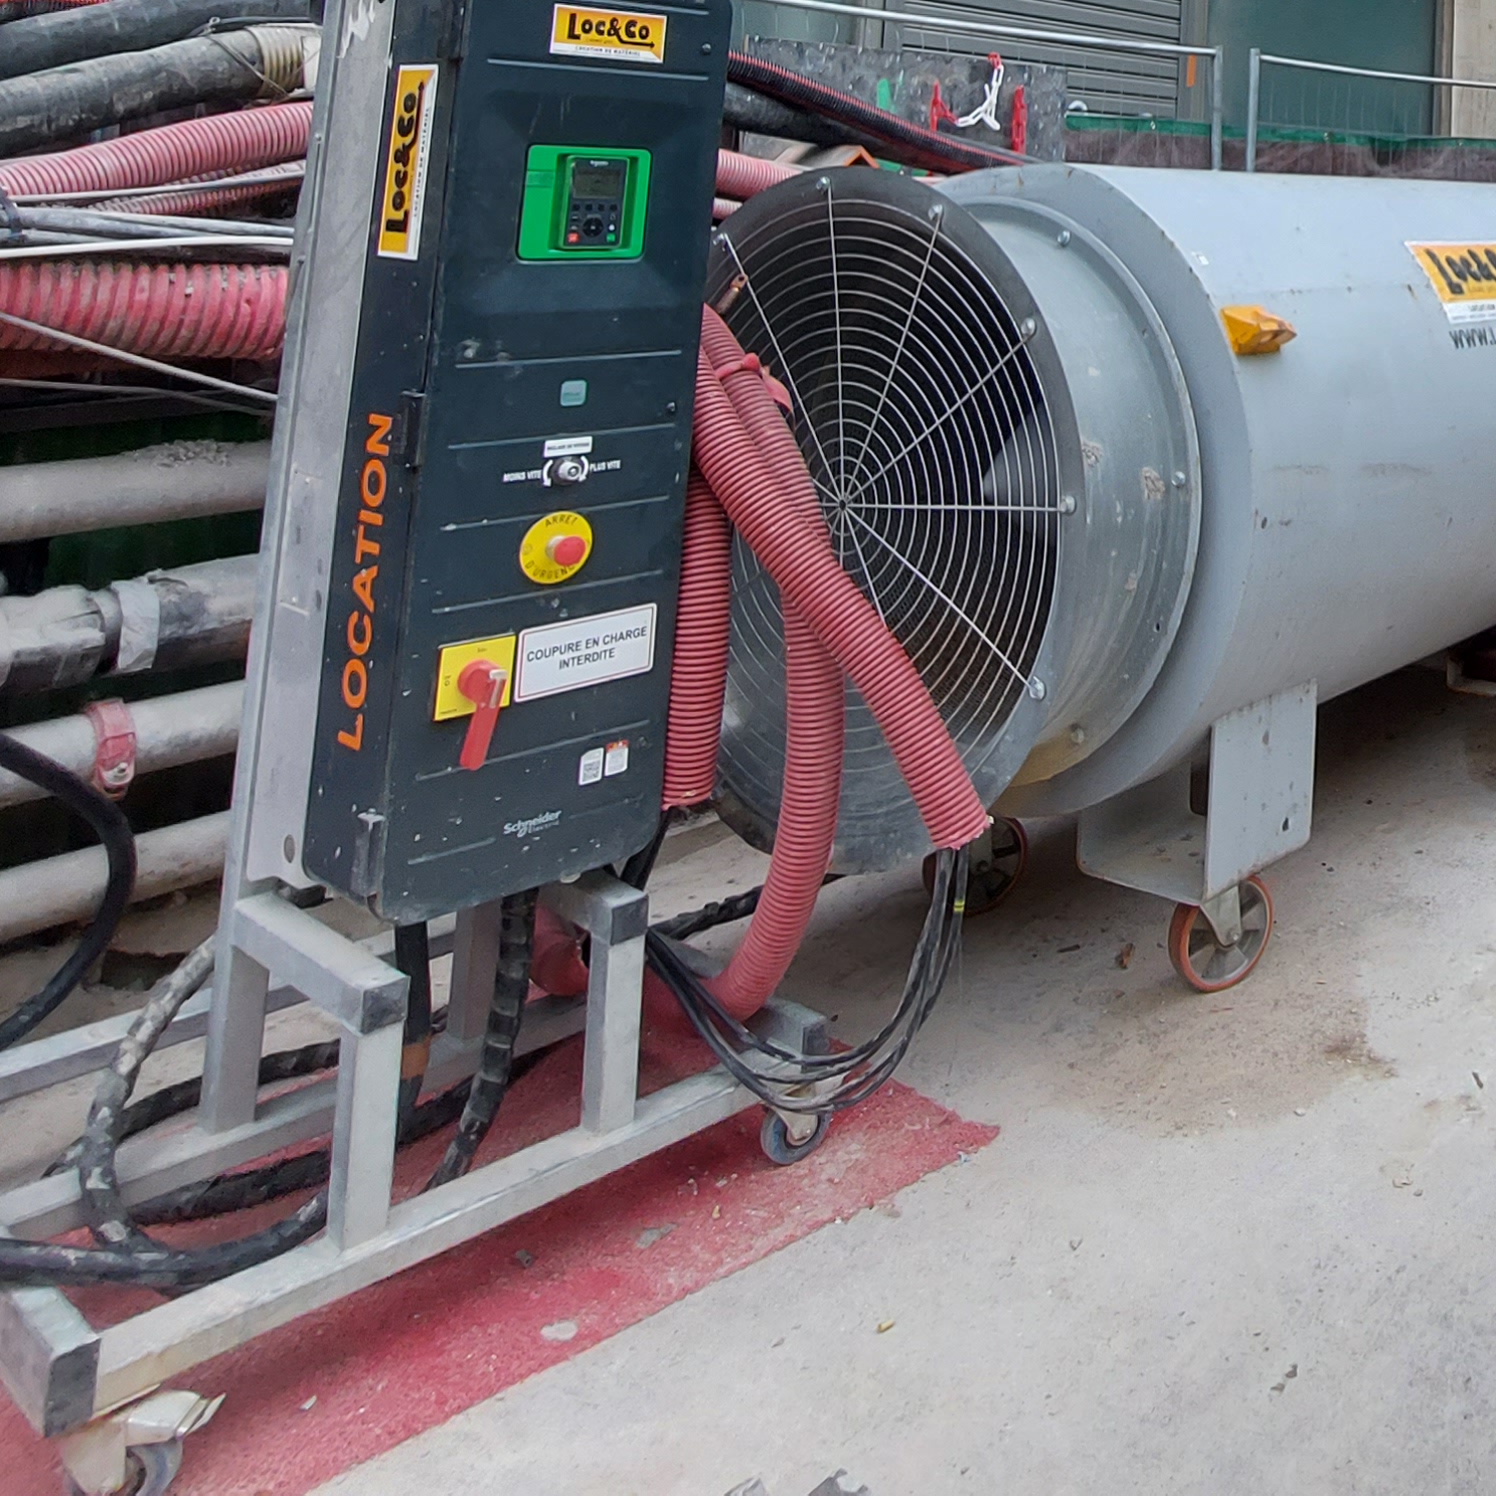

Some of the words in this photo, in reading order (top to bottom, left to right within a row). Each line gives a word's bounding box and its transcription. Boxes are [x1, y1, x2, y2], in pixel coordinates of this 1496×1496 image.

[527, 469, 542, 479] VITE
[607, 459, 621, 470] VITE
[336, 412, 393, 752] LOCATION
[526, 640, 582, 662] COUPURE
[585, 636, 600, 650] EN
[602, 626, 648, 645] CHARGE
[558, 647, 616, 670] INTERDITE
[503, 810, 562, 838] Schneider
